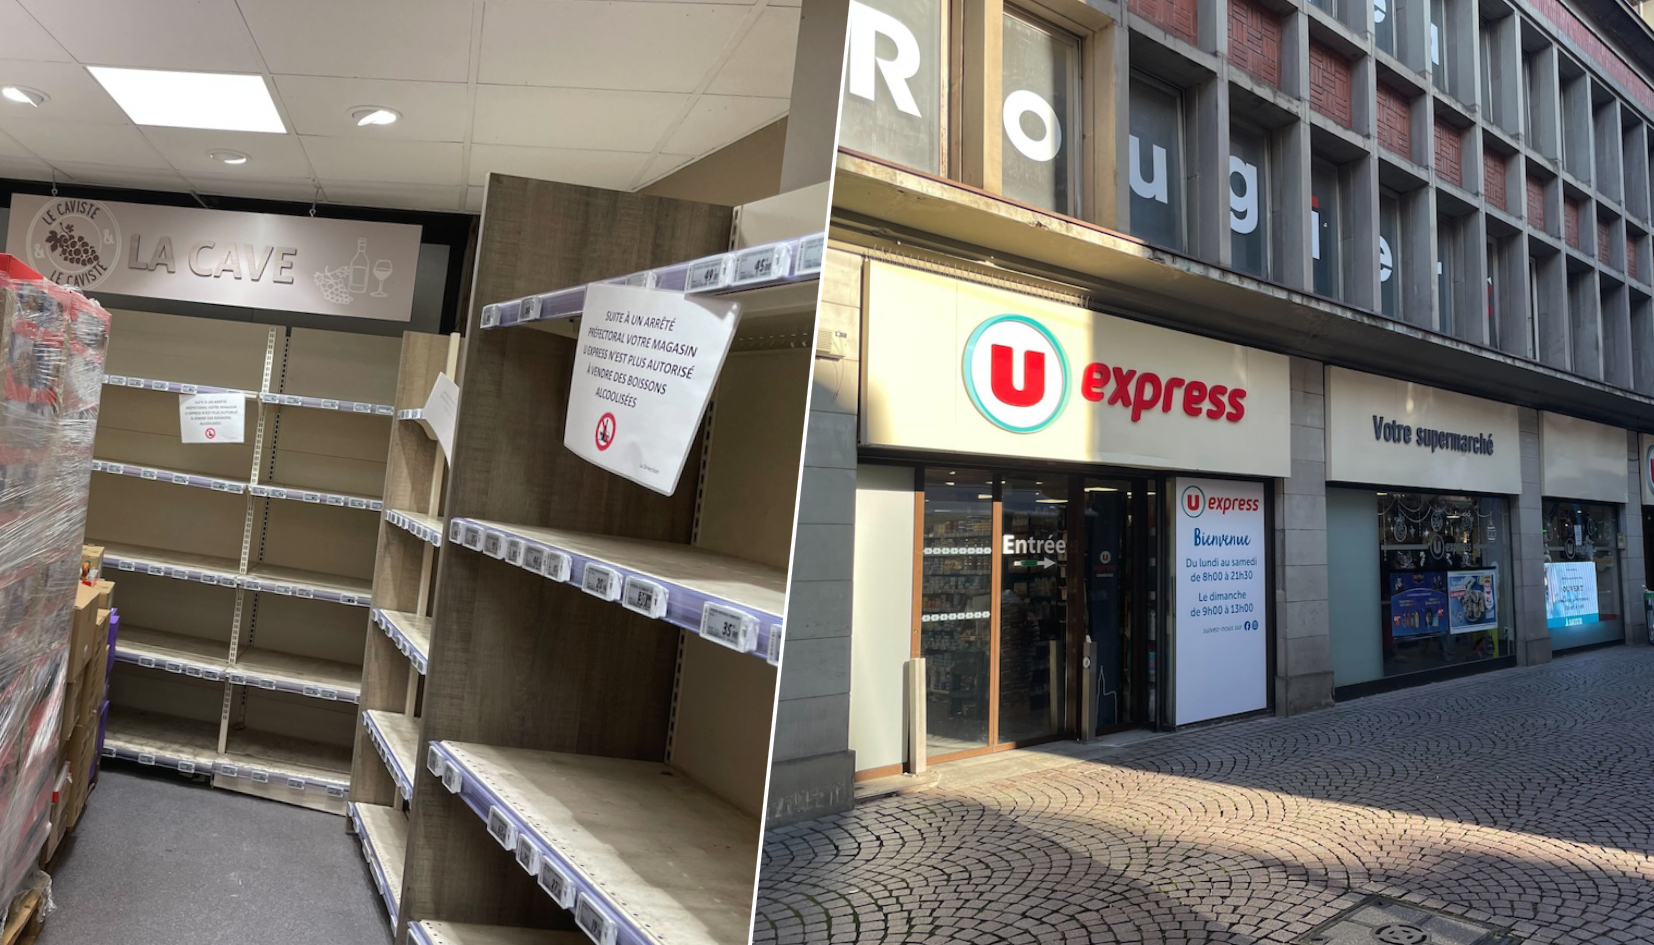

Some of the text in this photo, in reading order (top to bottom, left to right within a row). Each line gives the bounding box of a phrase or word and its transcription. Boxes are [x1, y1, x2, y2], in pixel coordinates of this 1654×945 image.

[42, 200, 101, 226] LE CAVISTE
[127, 233, 298, 284] LA CAVE
[50, 260, 108, 287] LE CAVISTE
[606, 310, 676, 332] SUITE À UN ARRÊTÉ
[588, 326, 698, 358] PRÉFECTORAL VOTRE MAGASIN
[583, 344, 695, 380] U EXPRESS N'EST PLUS AUTORISÉ
[586, 362, 667, 394] À VENDRE DES BOISSONS
[595, 386, 638, 408] ALCOOLISÉES
[1080, 362, 1247, 422] express
[1372, 414, 1494, 456] Votre supermarché
[1208, 496, 1260, 514] express
[1002, 534, 1067, 555] Entrée
[1193, 528, 1252, 548] Bienvenue
[1186, 556, 1258, 568] Du lundi au samedi
[1190, 570, 1253, 582] de 8h00 à 21h30
[1198, 590, 1246, 602] Le dimanche
[1190, 602, 1254, 617] de 9h00 à 13h00
[1202, 625, 1234, 634] suivez-nous
